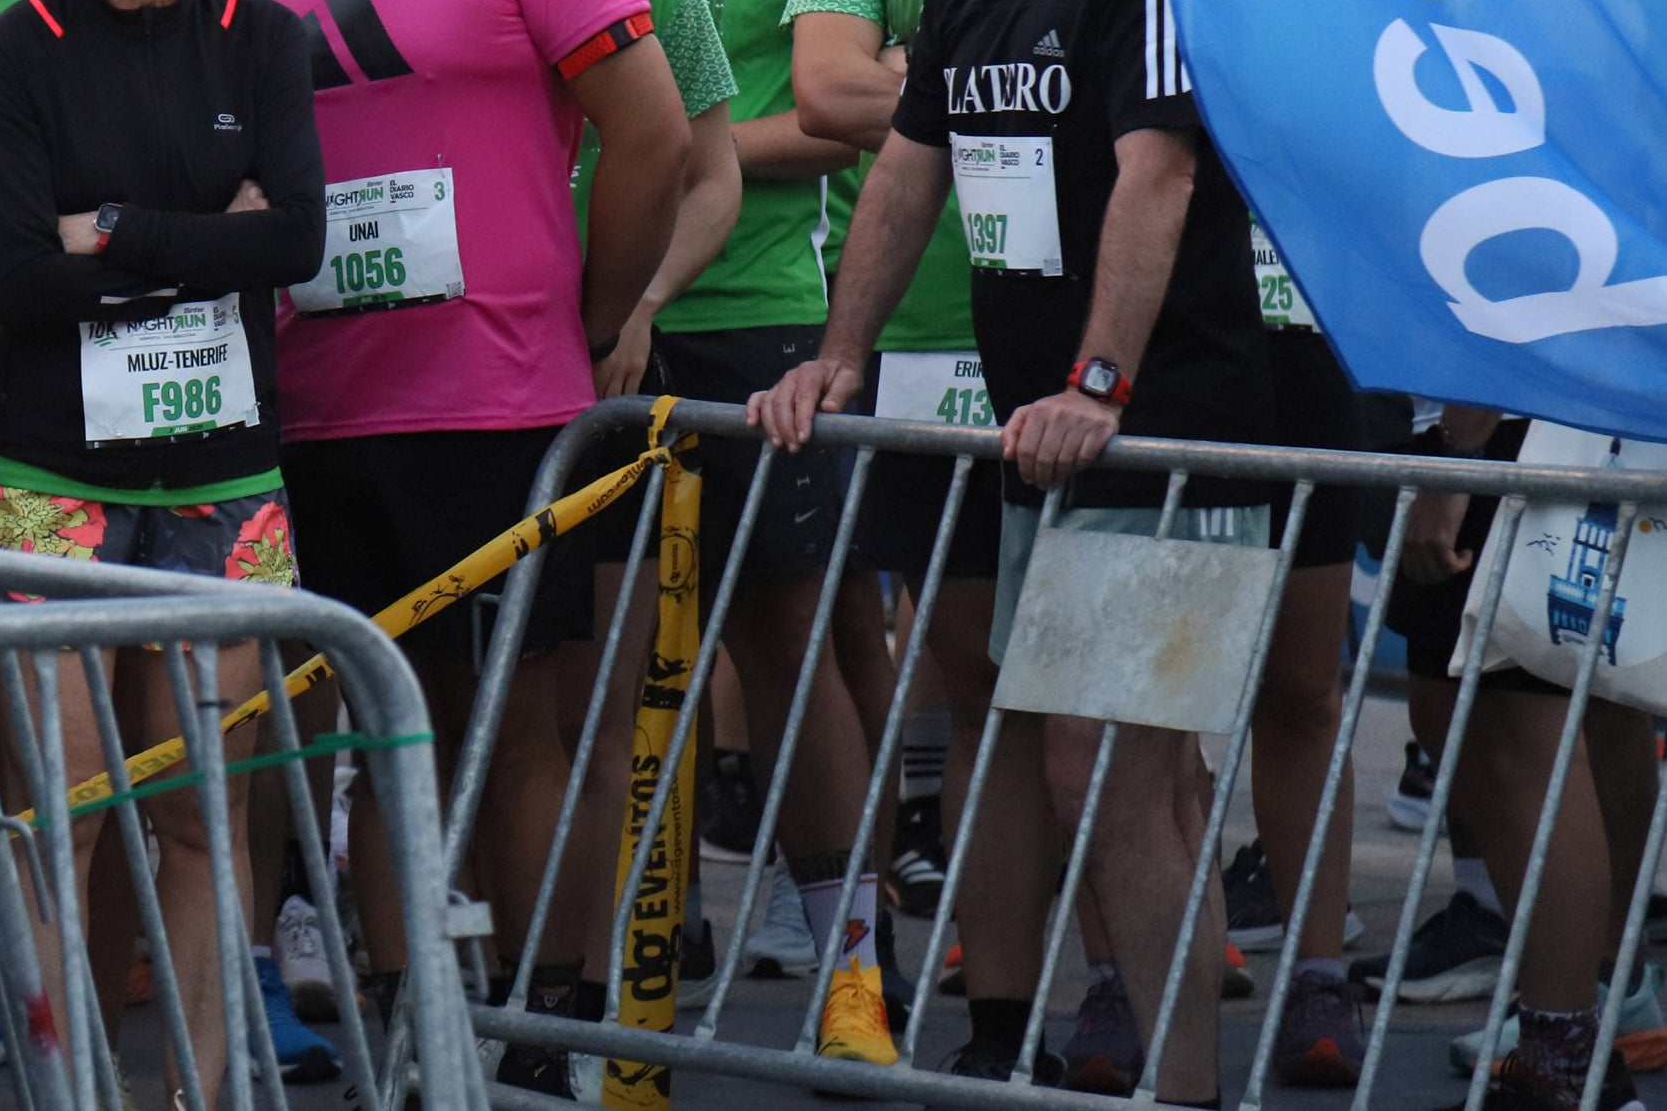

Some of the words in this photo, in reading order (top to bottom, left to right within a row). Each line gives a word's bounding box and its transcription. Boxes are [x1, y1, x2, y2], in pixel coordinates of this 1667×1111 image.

[1033, 47, 1065, 57] adidas
[1034, 148, 1044, 166] 2
[390, 184, 415, 193] DIARIO
[390, 191, 414, 200] VASCO
[433, 181, 446, 201] 3
[349, 221, 379, 242] UNAI
[967, 213, 1008, 254] 1397
[330, 246, 407, 294] 1056
[127, 343, 228, 373] MLUZ-TENERIFE
[142, 375, 222, 423] F986
